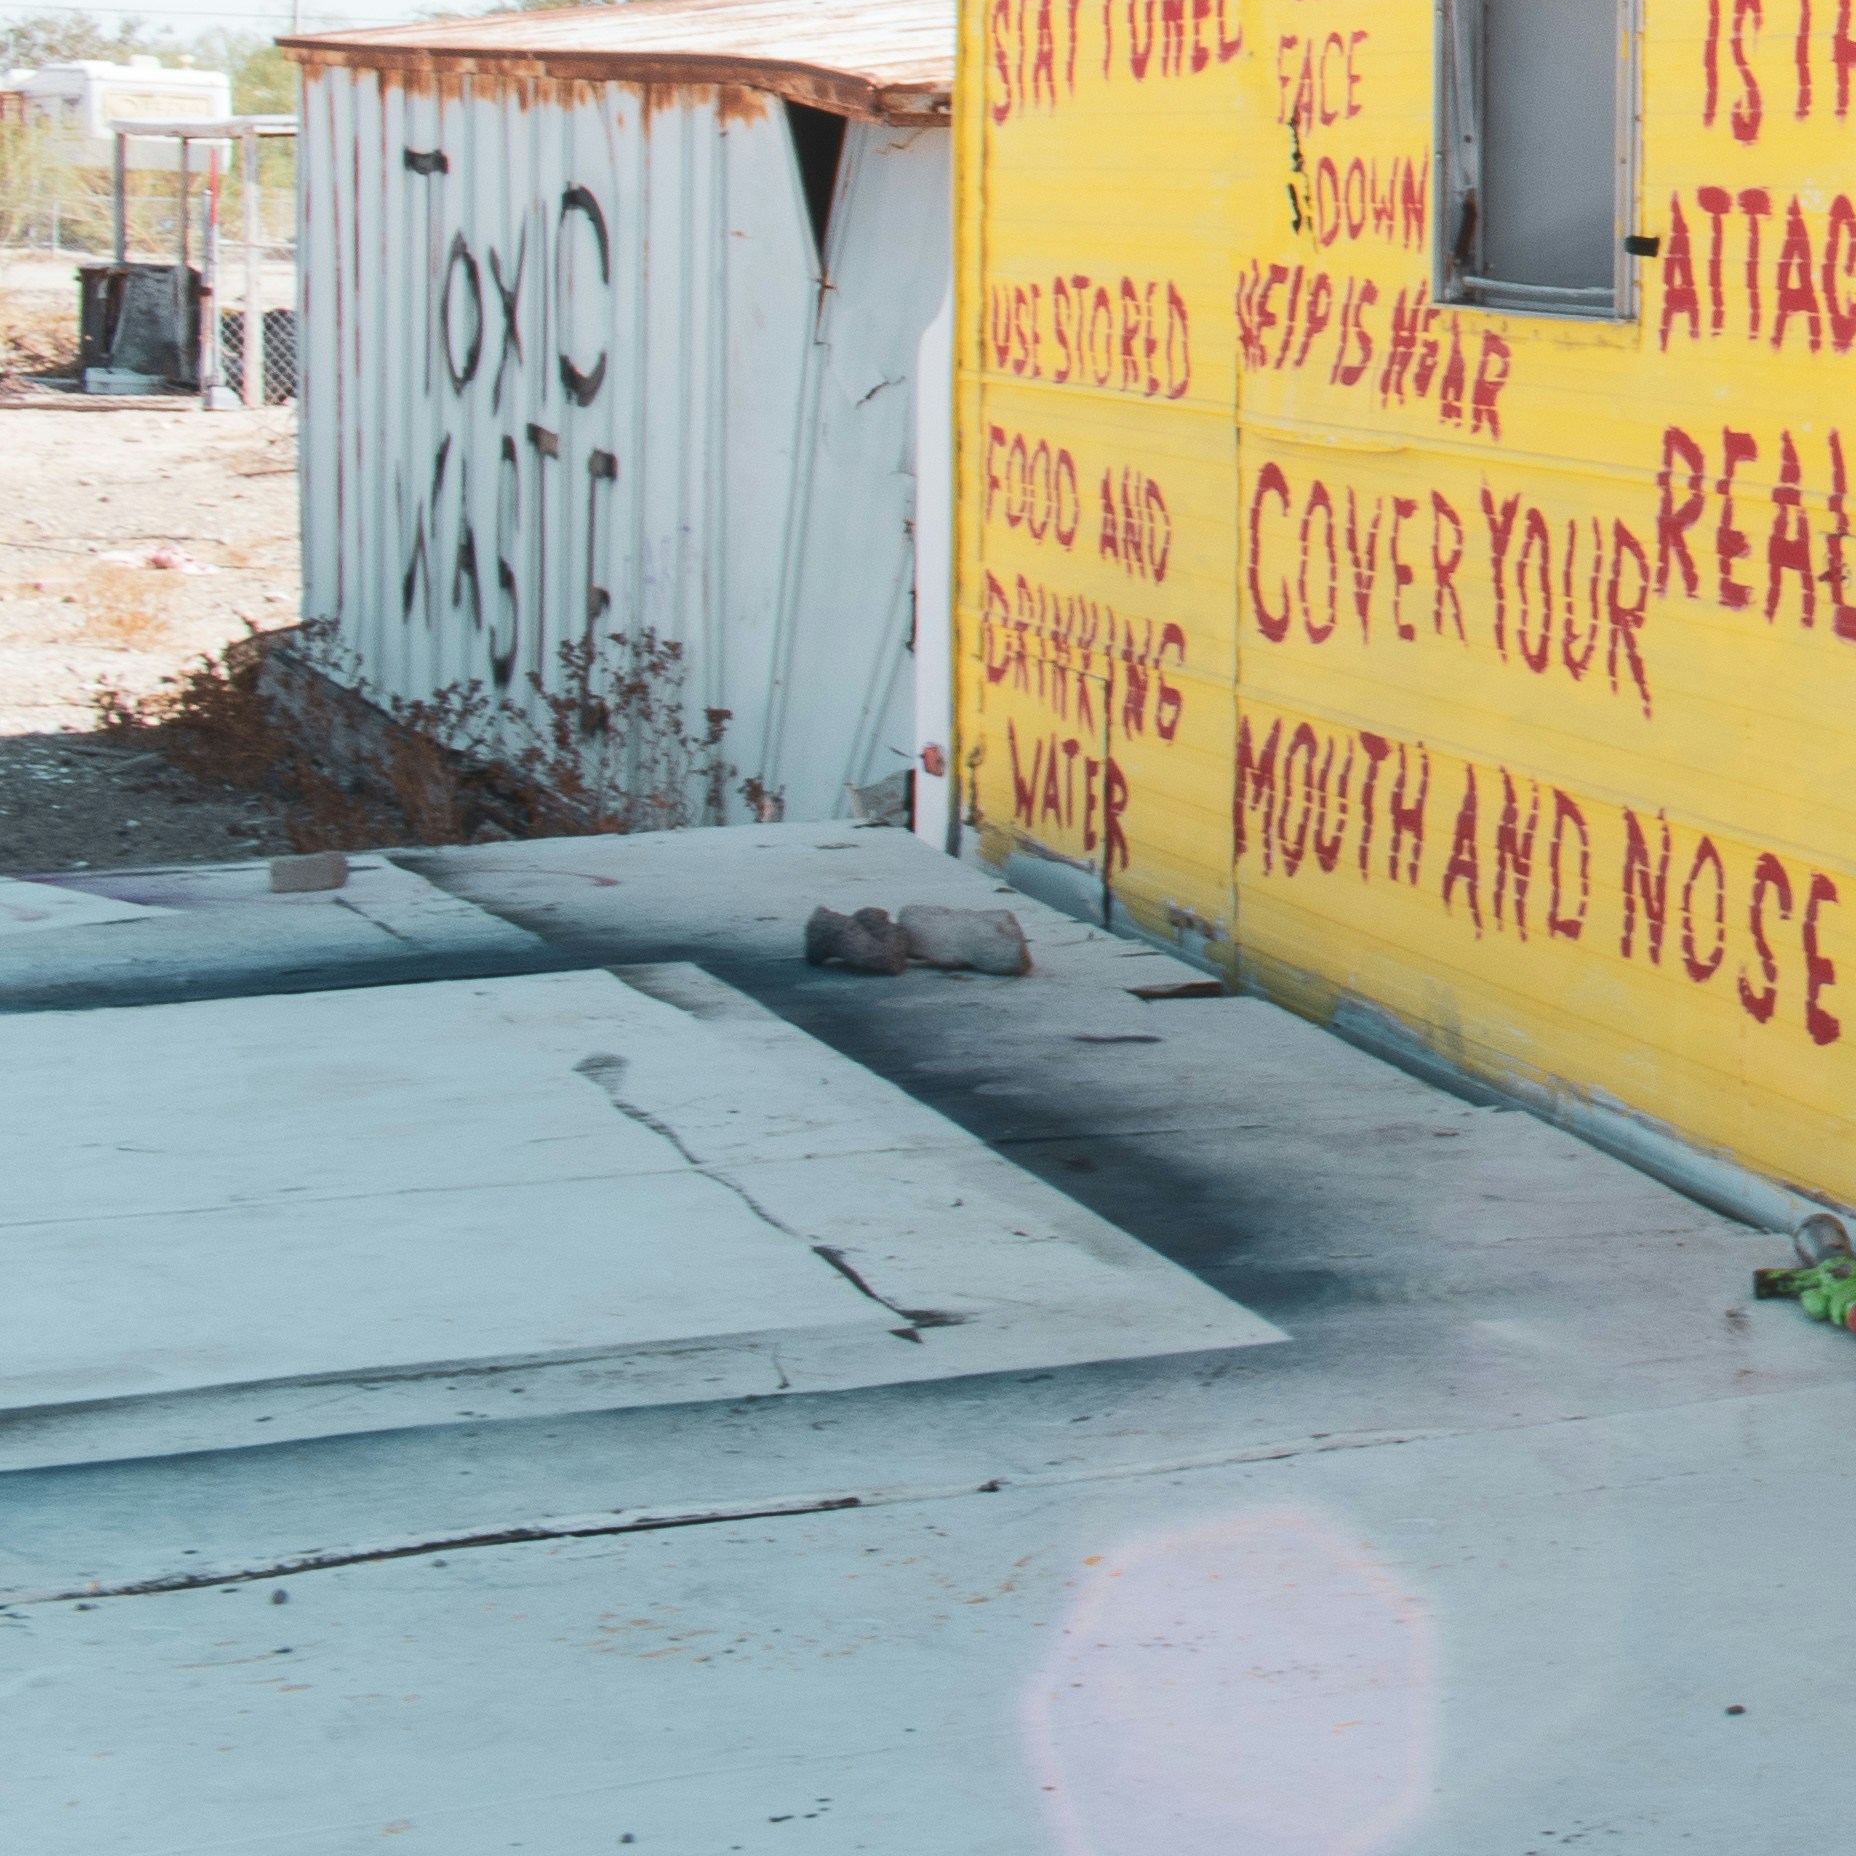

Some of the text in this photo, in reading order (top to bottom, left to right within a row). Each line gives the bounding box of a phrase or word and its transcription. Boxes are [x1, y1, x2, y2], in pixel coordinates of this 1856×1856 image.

[1277, 28, 1370, 136] FACE
[1317, 145, 1429, 253] DOWN
[987, 273, 1191, 401] USE STORED
[1329, 276, 1379, 386] IS
[984, 421, 1172, 586] FOOD AND
[1246, 460, 1654, 722] COVER YOUR
[1007, 716, 1131, 874] WATER
[1232, 713, 1844, 1046] MOUTH AND NOSE
